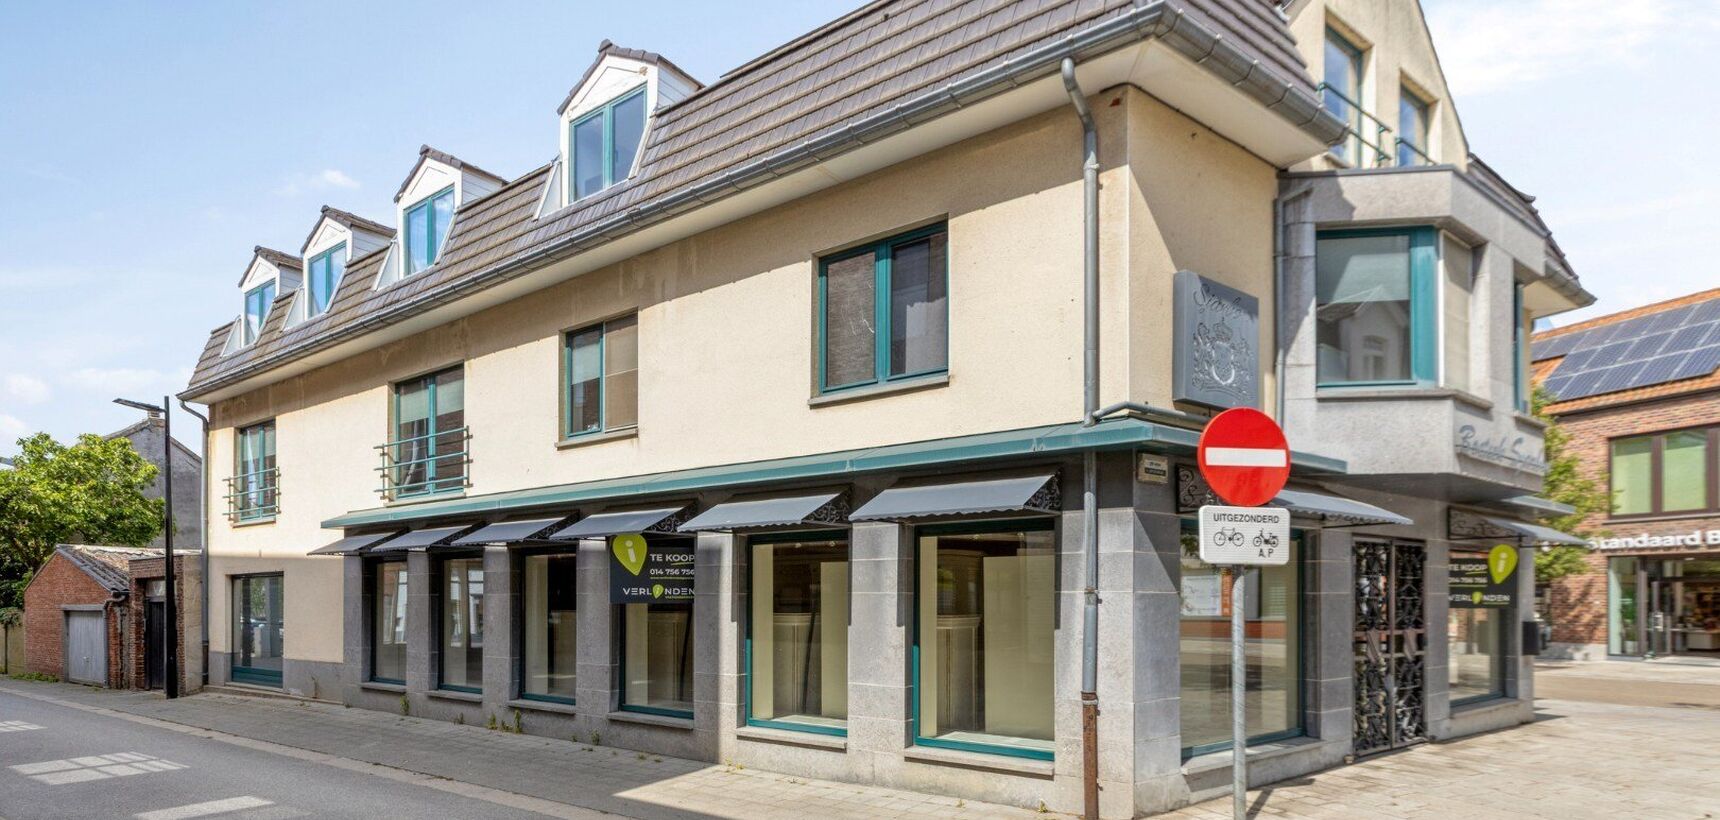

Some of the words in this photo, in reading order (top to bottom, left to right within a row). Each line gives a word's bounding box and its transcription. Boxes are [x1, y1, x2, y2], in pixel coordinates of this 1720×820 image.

[1213, 513, 1280, 523] UITGEZONDERD
[1586, 530, 1701, 550] Standaard
[649, 554, 663, 562] TE
[665, 554, 695, 562] KOOP
[1267, 548, 1274, 558] P
